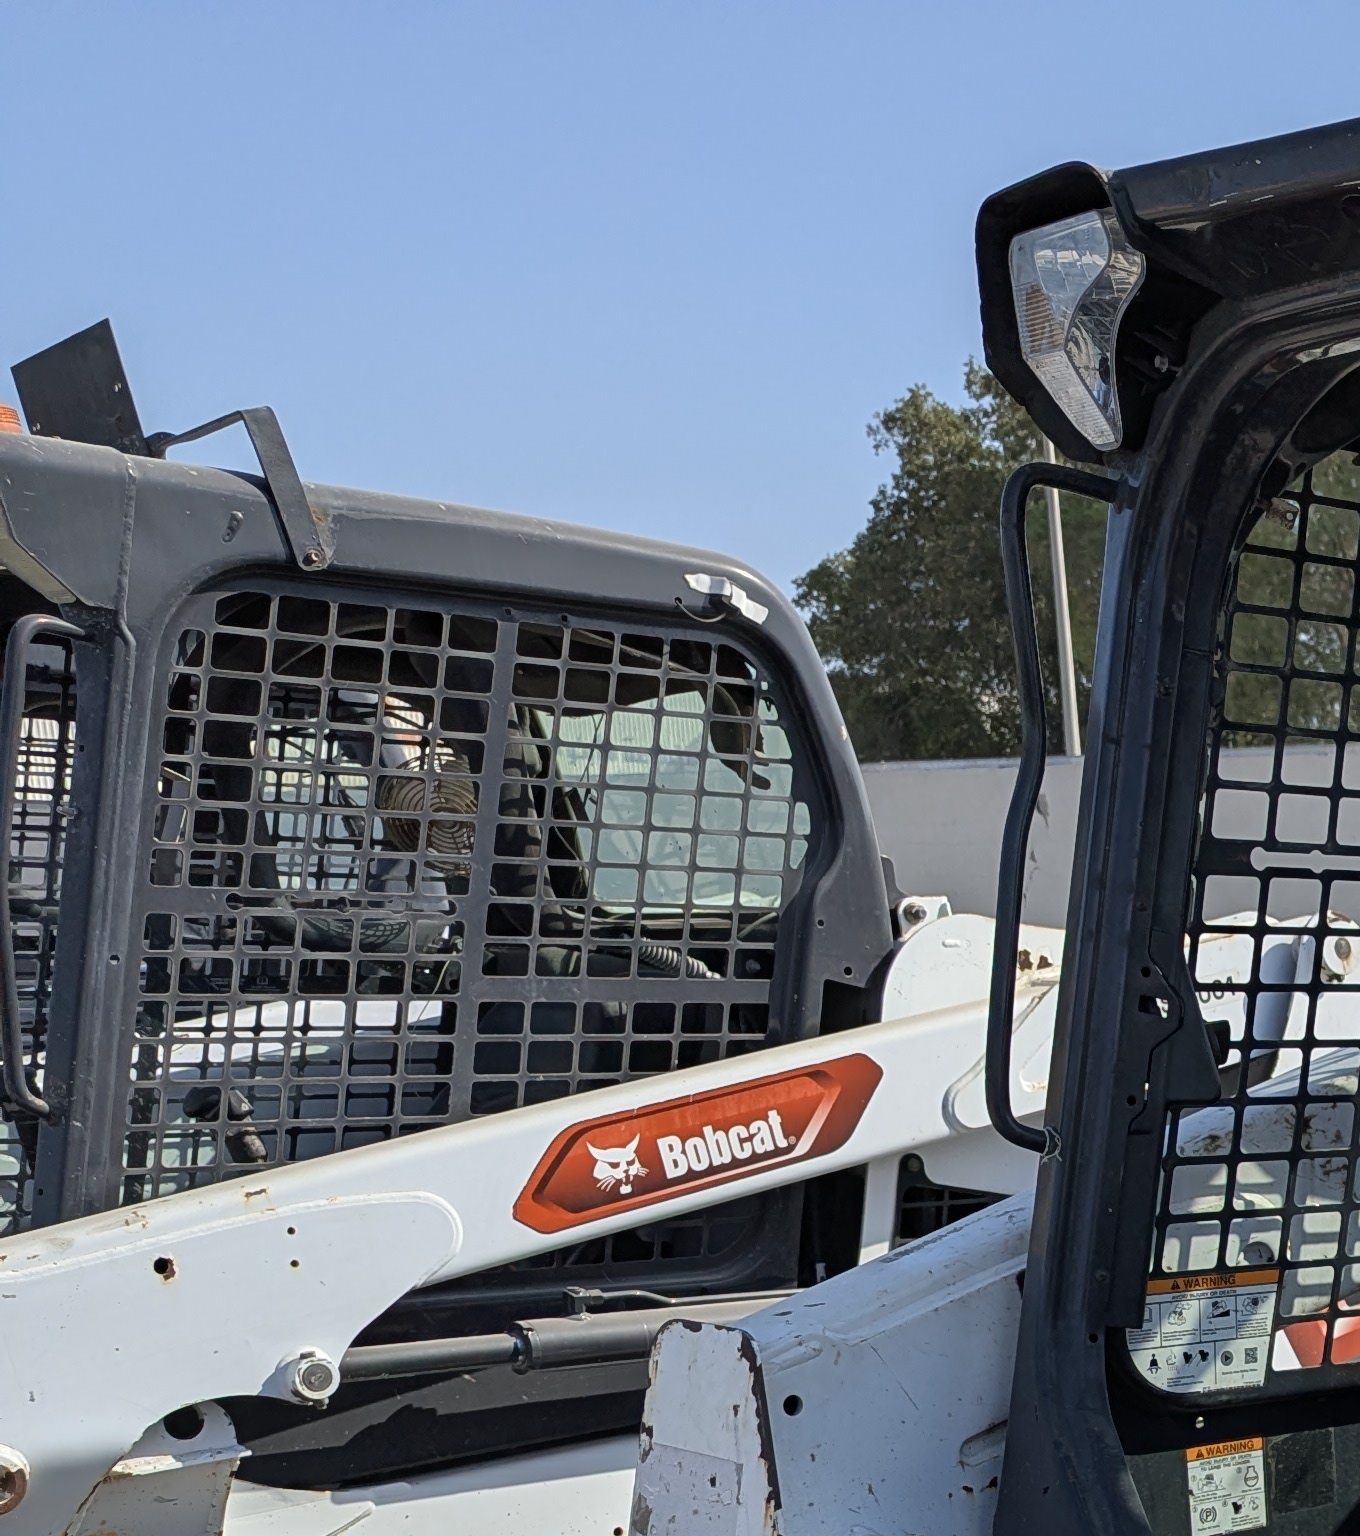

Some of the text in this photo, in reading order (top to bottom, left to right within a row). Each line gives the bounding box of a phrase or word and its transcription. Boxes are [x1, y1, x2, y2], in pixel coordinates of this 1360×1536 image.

[657, 1110, 788, 1179] Bobcat
[1183, 1275, 1237, 1290] WARNING
[1206, 1440, 1254, 1456] WARNING
